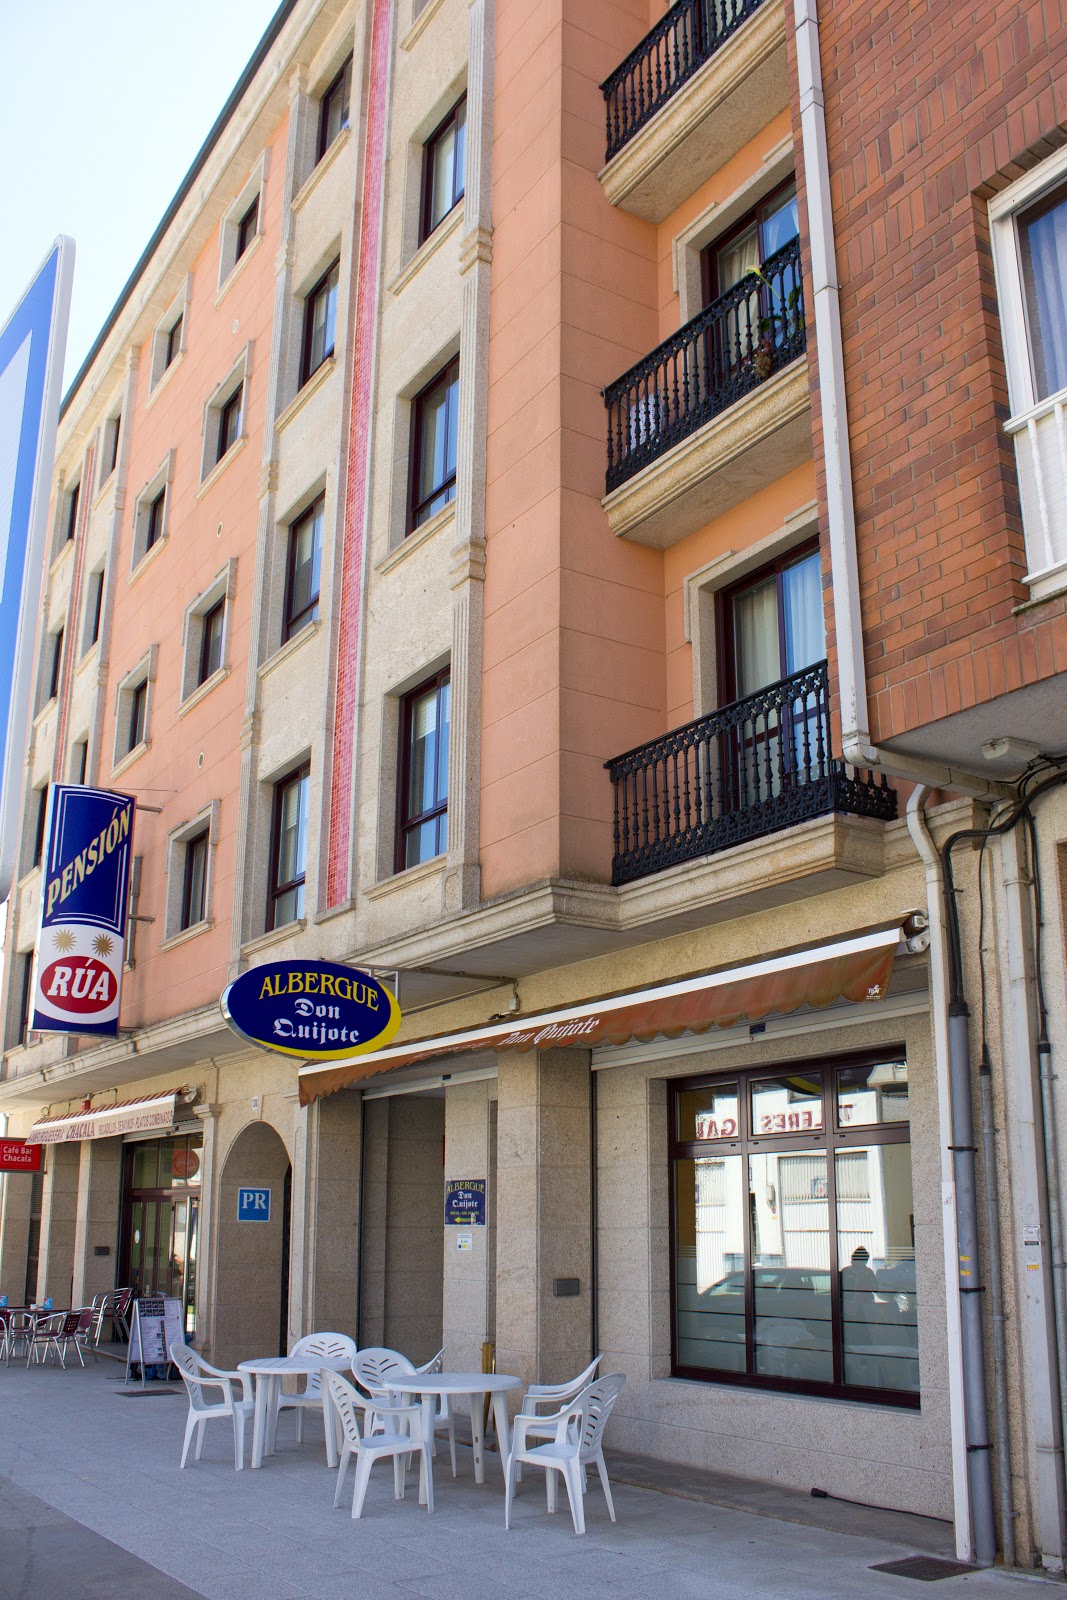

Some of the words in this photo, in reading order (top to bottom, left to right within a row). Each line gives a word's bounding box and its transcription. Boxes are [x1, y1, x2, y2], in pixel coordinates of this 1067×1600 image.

[45, 803, 132, 918] PENSIÓN
[46, 958, 110, 1001] RÚA
[258, 972, 380, 1011] ALBERGUE
[294, 998, 341, 1020] Don
[273, 1018, 360, 1045] Quijote
[496, 1031, 535, 1045] Don
[534, 1016, 600, 1044] Quijote
[66, 1121, 95, 1140] CHACALA
[3, 1145, 19, 1154] Café
[20, 1147, 32, 1155] Bar
[3, 1153, 32, 1163] Chacala
[446, 1181, 485, 1195] ALBERGUE
[457, 1190, 472, 1199] Don
[241, 1192, 268, 1210] PR
[451, 1199, 479, 1210] Quijote
